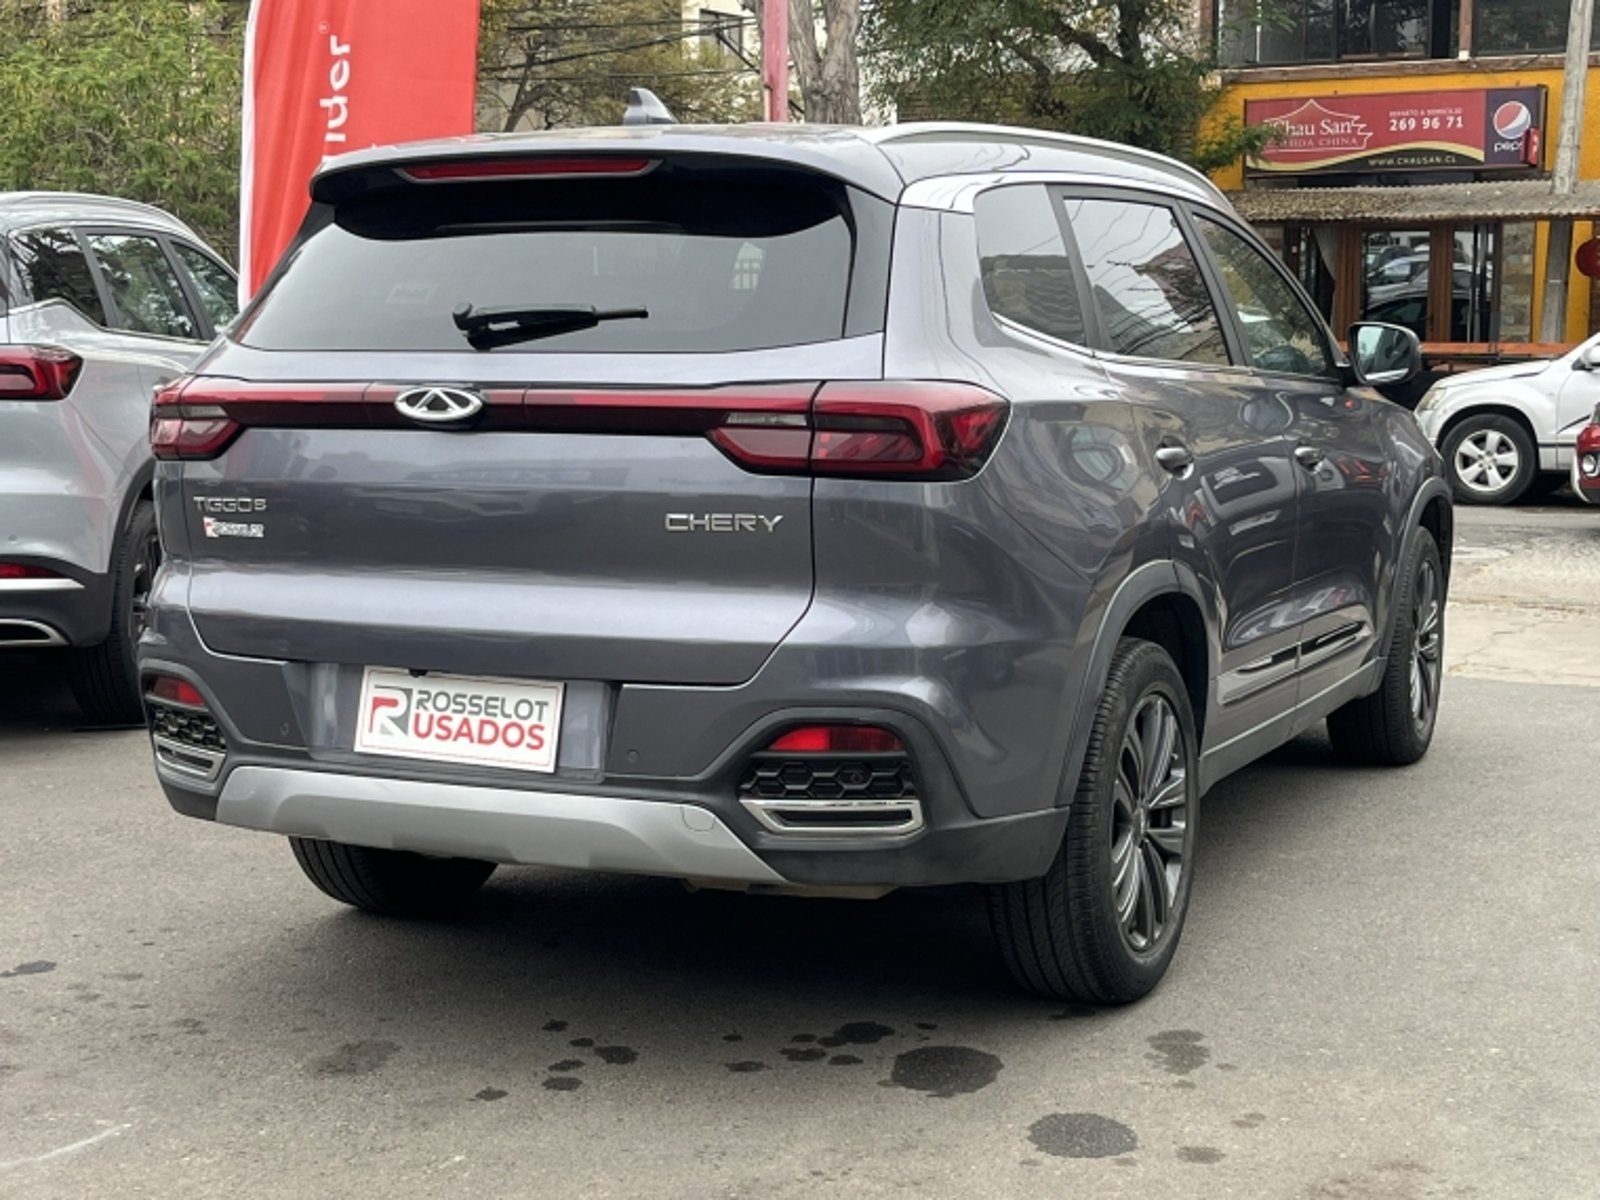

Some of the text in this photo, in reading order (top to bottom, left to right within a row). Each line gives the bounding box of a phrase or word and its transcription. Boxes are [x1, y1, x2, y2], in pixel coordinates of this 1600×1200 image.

[319, 35, 350, 163] ider
[1320, 118, 1353, 134] San
[1389, 115, 1464, 131] 269 96 71
[193, 496, 252, 512] TIGGO
[665, 513, 784, 532] CHERY
[415, 690, 549, 722] ROSSELOT
[413, 713, 545, 750] USADOS
